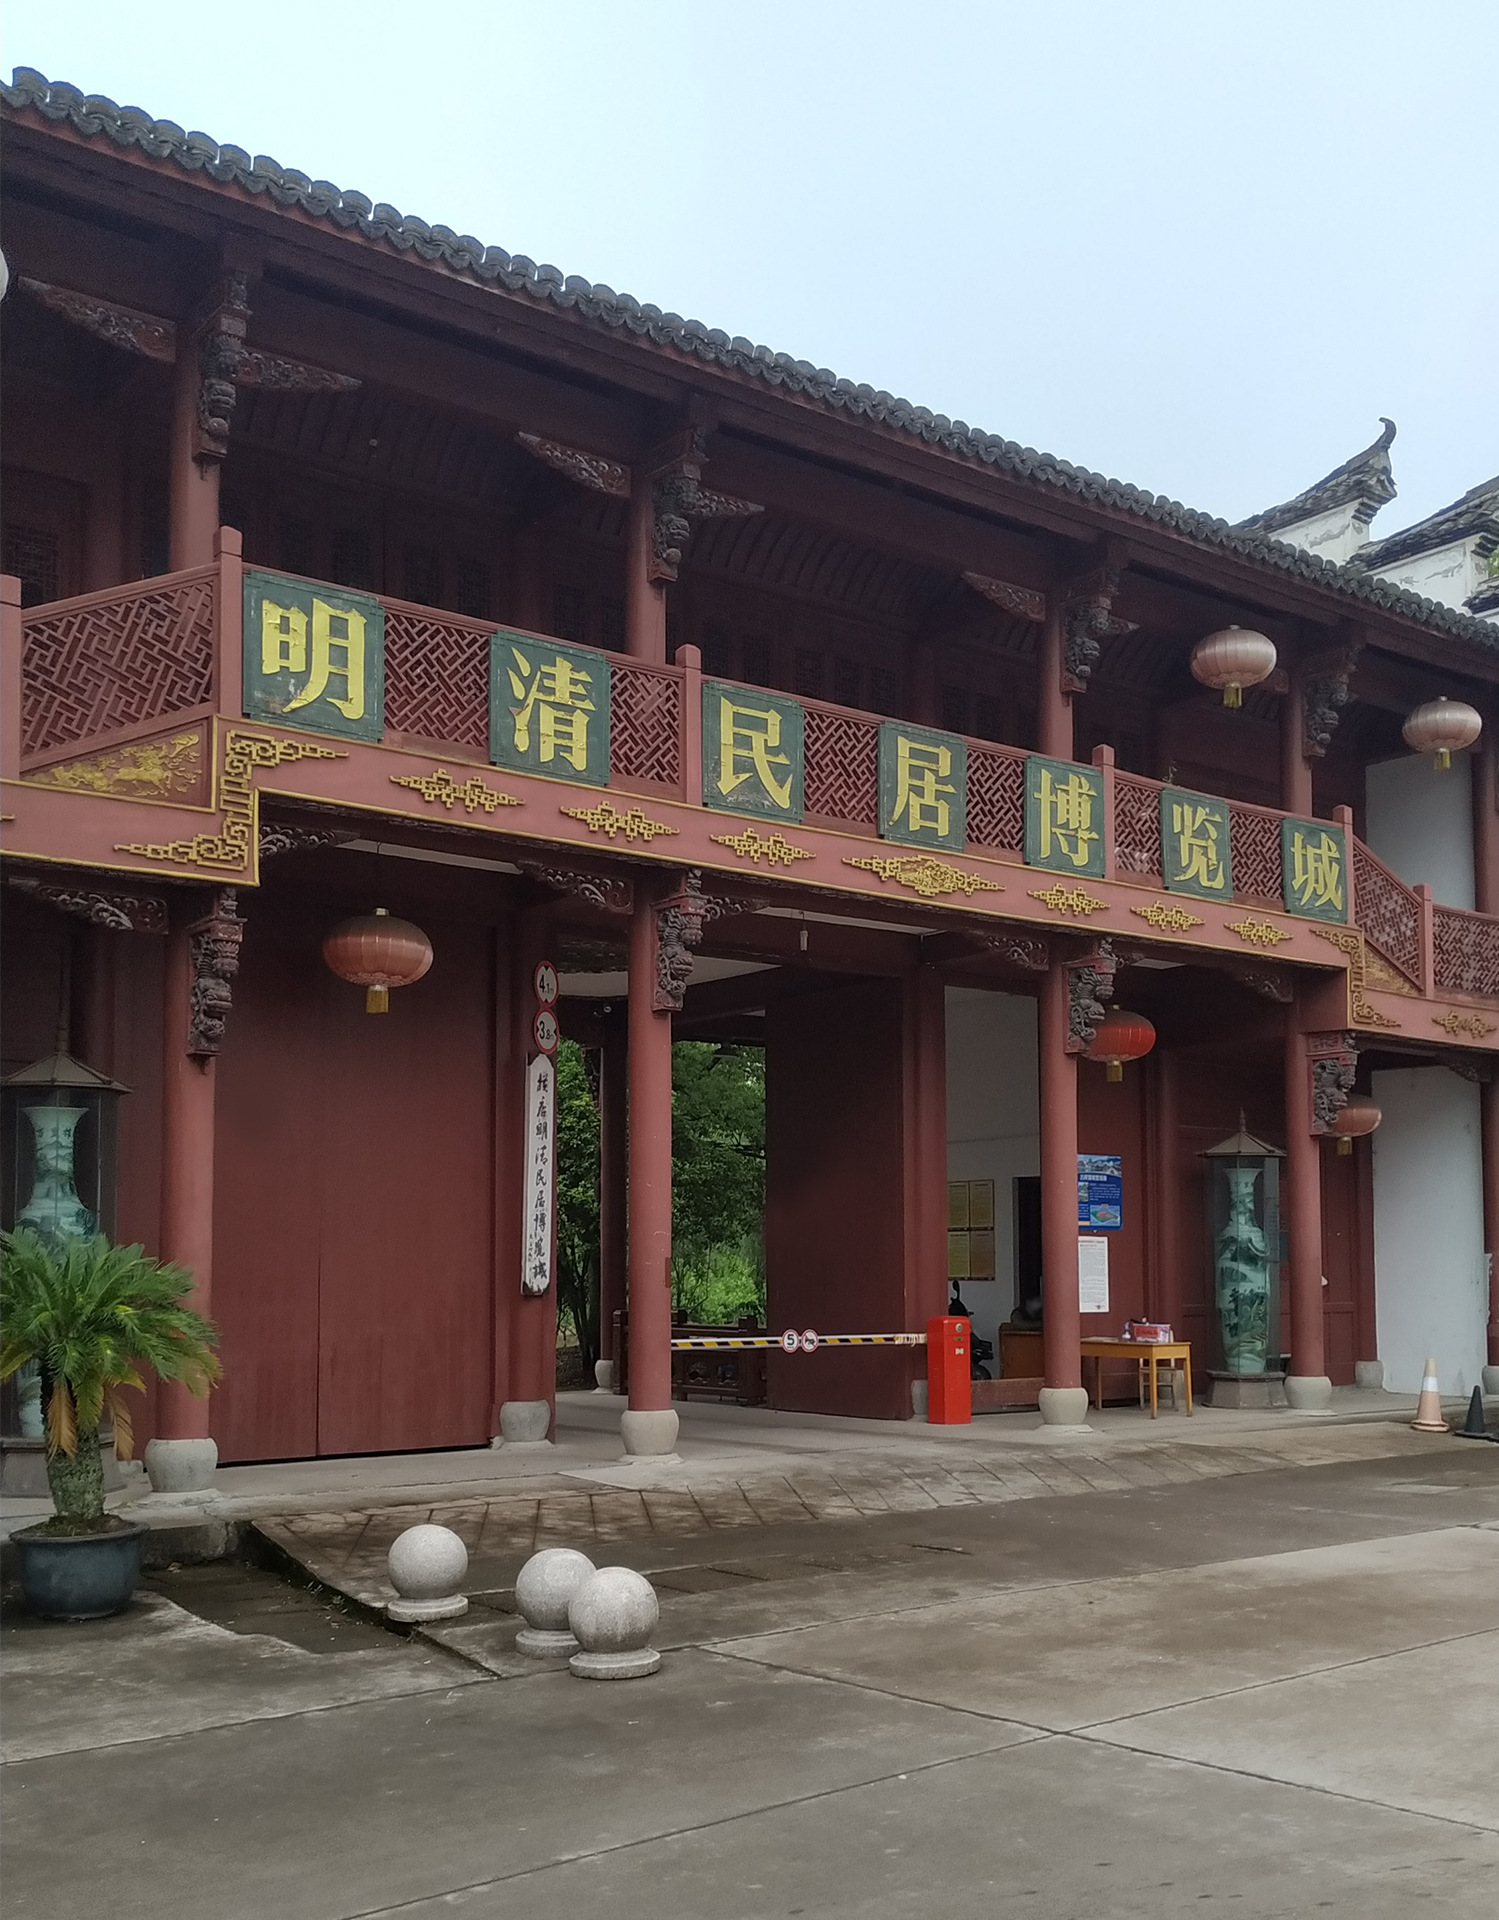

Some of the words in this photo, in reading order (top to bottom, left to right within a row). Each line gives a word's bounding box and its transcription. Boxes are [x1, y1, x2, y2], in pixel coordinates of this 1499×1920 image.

[261, 597, 1343, 911] 明清民居博览城
[787, 1334, 795, 1346] 5
